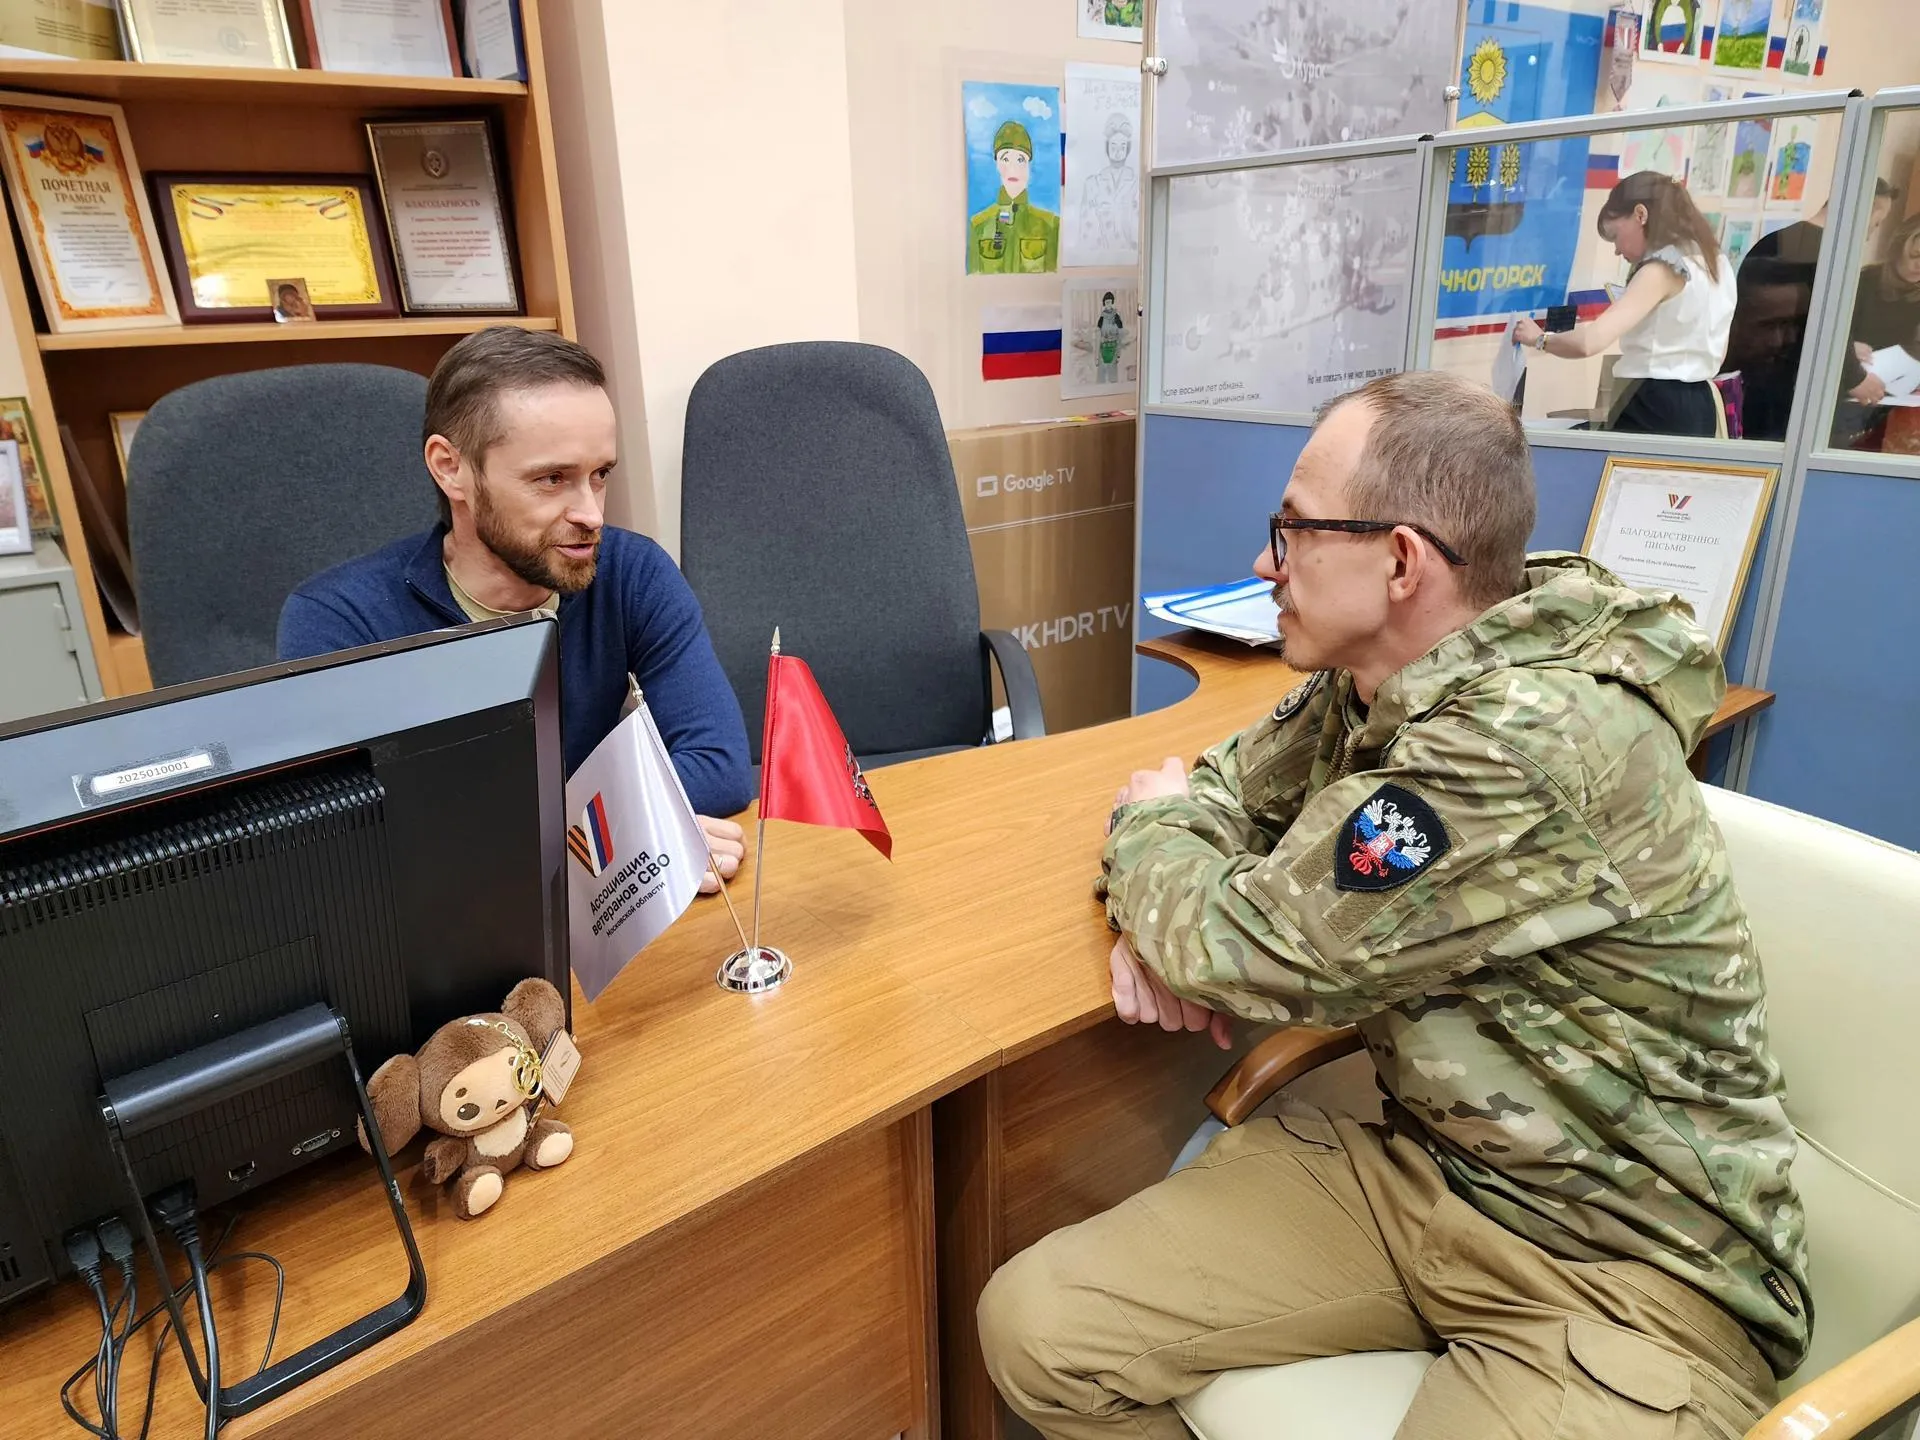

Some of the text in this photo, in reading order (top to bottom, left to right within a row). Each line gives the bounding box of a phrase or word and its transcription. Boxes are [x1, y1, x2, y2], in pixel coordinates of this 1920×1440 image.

[41, 178, 112, 194] ПОЧЕТНАЯ
[54, 192, 106, 205] ГРАМОТА
[404, 199, 481, 210] БЛАГОДАРНОСТЬ
[1178, 384, 1205, 396] восьми
[1003, 466, 1075, 493] Google TV
[1619, 526, 1721, 546] БЛАГОДАРСТВЕННОЕ
[1644, 540, 1687, 553] ПИСЬМО
[116, 760, 190, 785] 2025010001
[590, 852, 650, 914] Ассоциация
[592, 852, 671, 936] ветеранов СВО
[606, 881, 666, 938] Московской области
